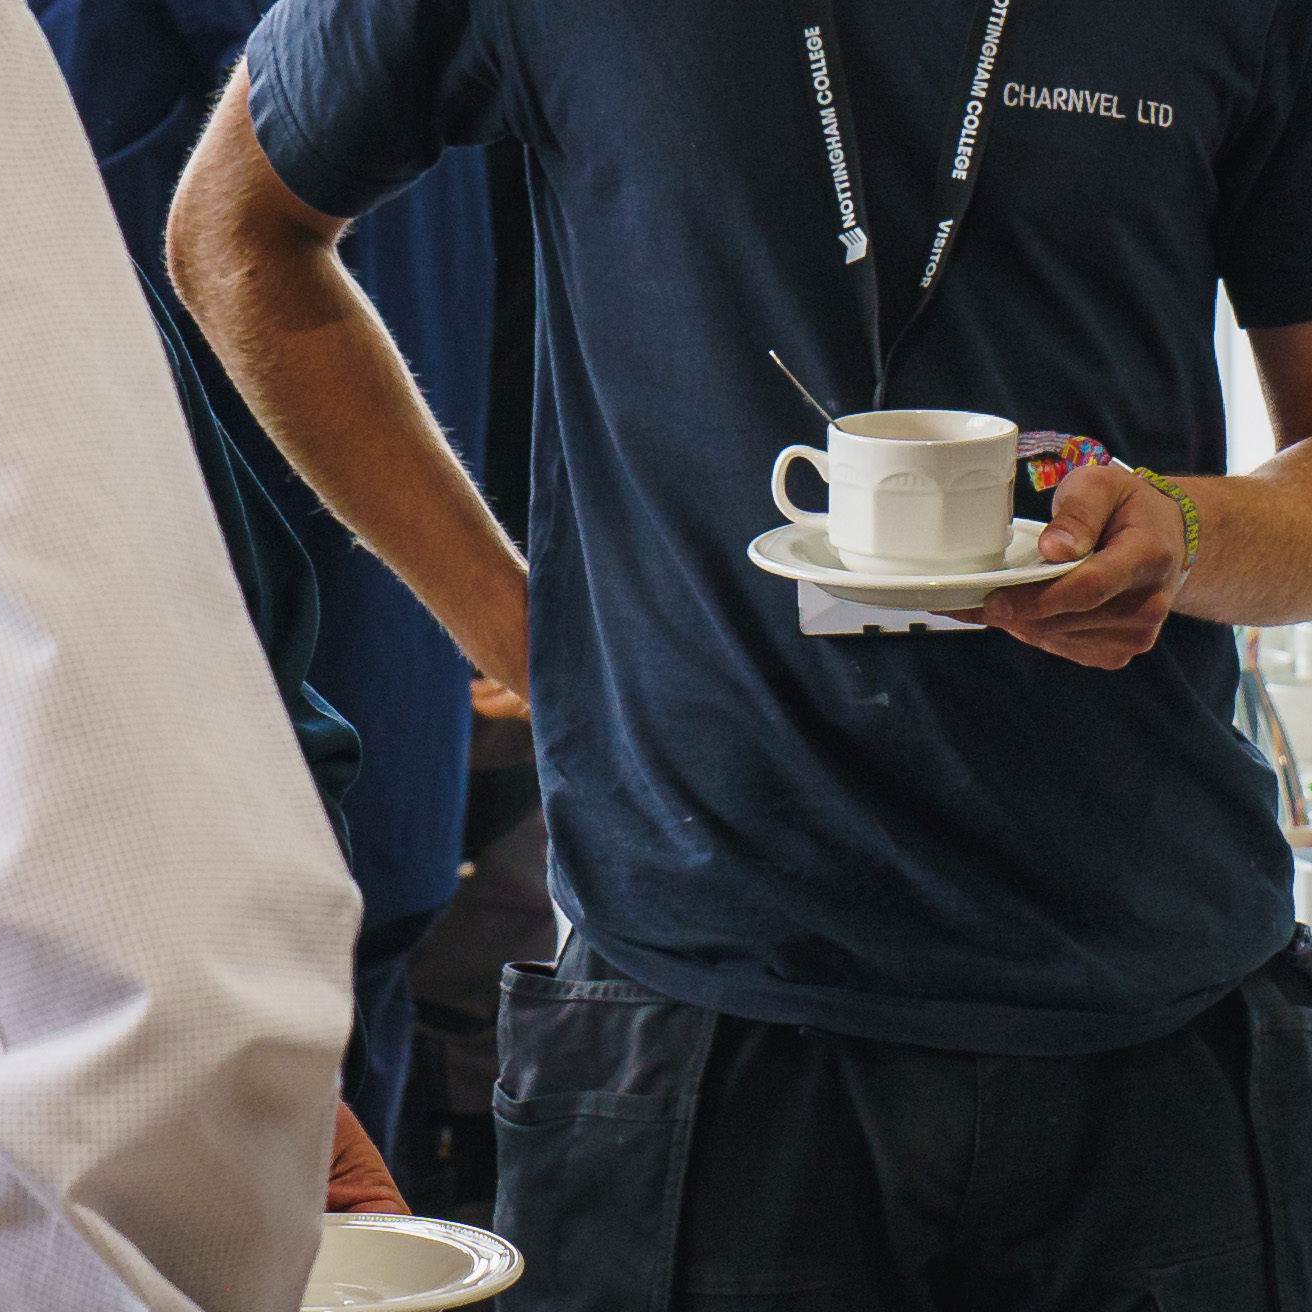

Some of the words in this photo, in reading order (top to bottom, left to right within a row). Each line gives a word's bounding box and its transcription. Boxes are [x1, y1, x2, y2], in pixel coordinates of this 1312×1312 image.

[804, 26, 833, 105] COLLEGE
[1003, 81, 1126, 119] CHARNVEL
[1137, 98, 1173, 128] LTD
[819, 106, 856, 229] NOTTINGHAM
[951, 99, 985, 181] COLLEGE
[920, 219, 954, 288] VISITOR
